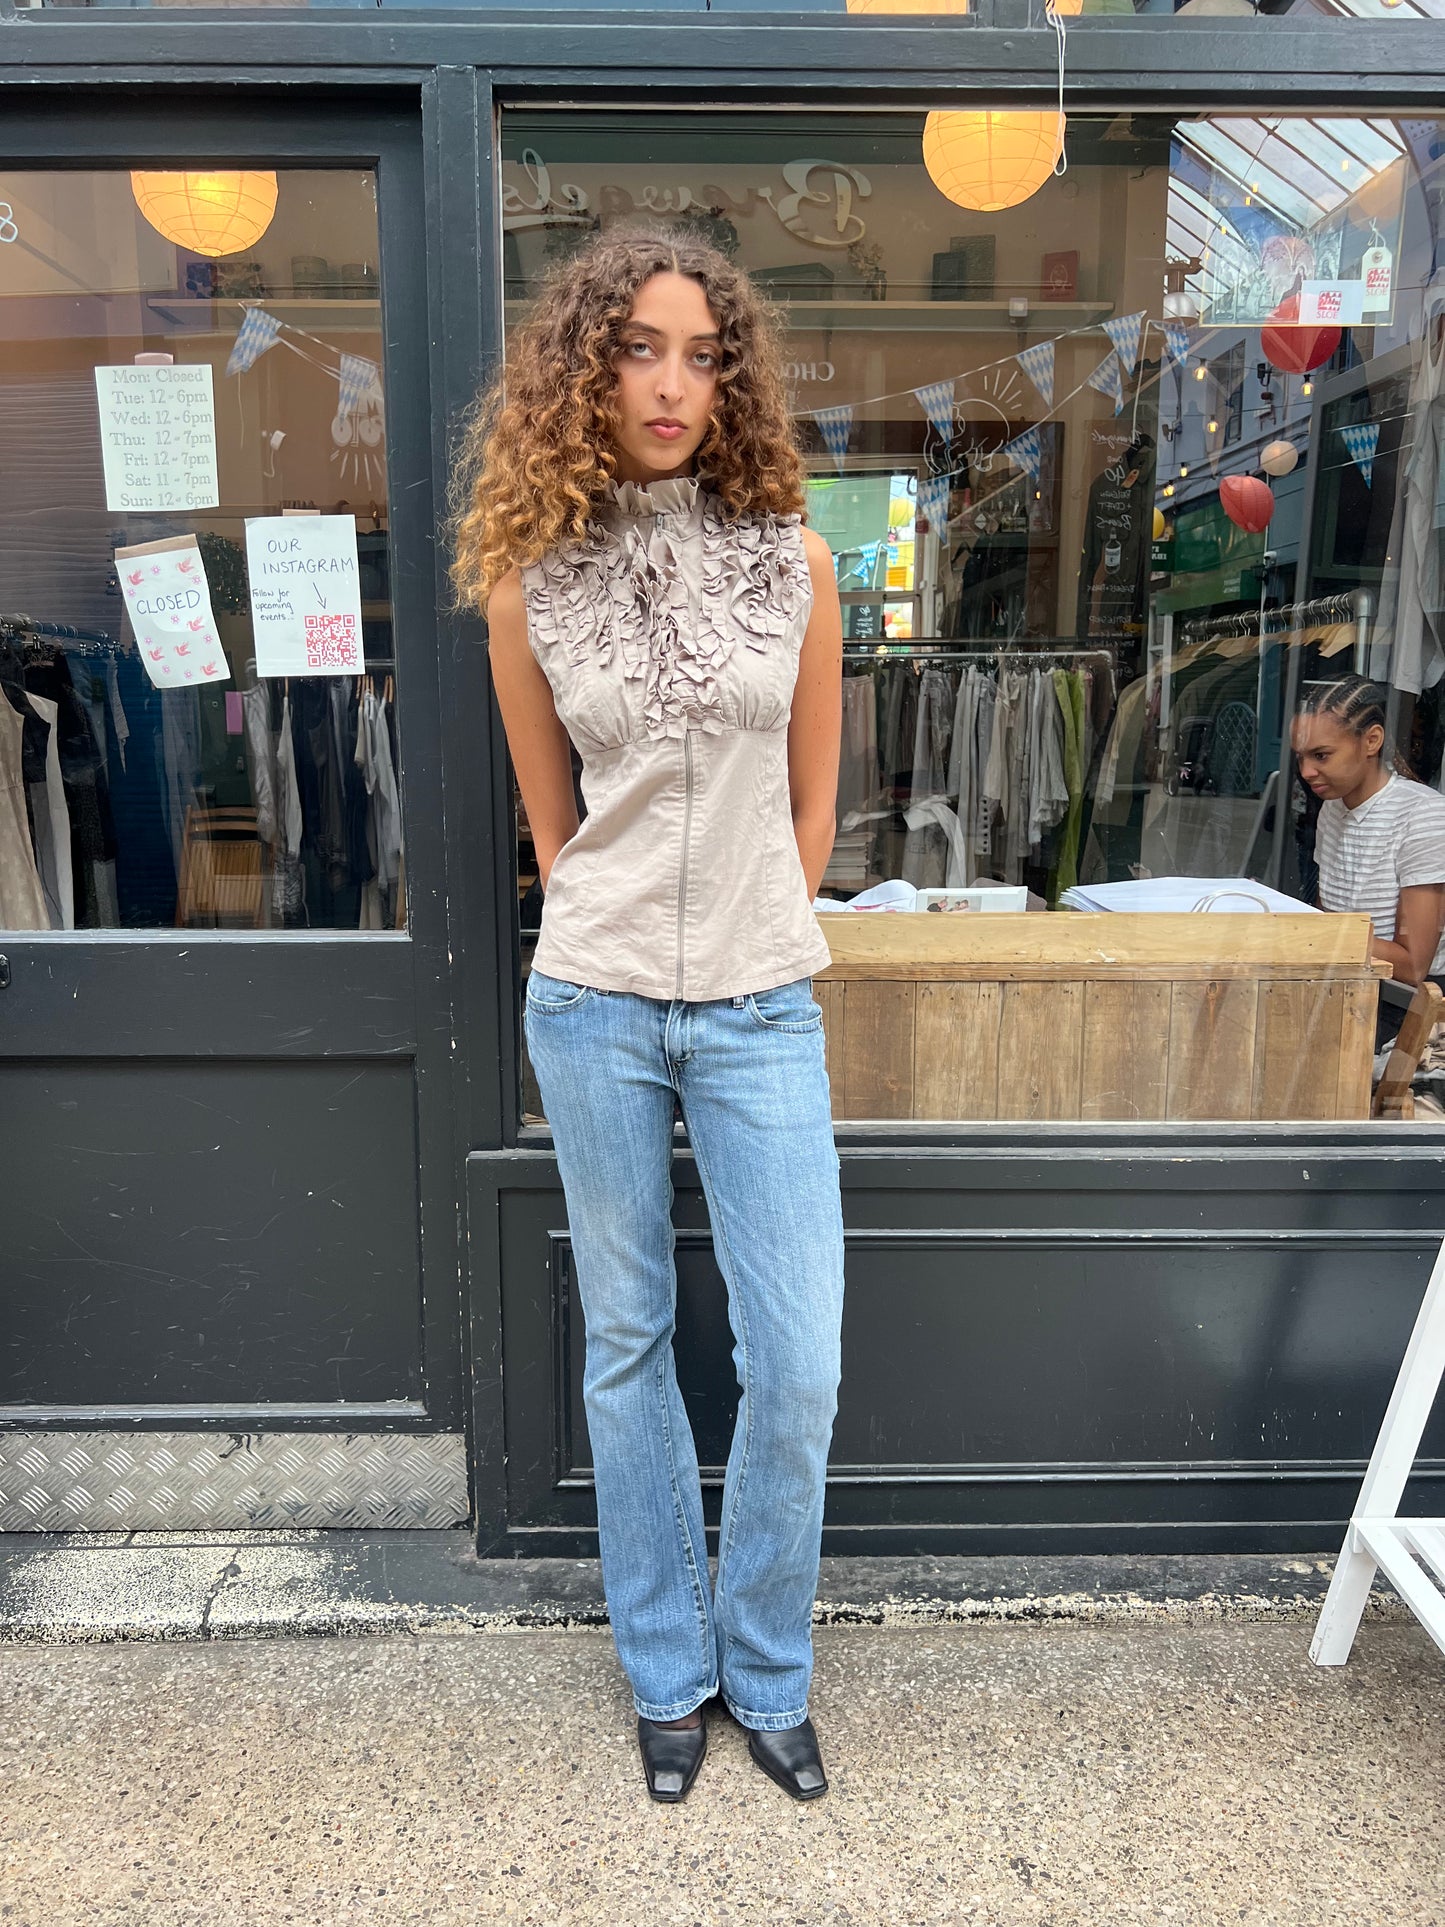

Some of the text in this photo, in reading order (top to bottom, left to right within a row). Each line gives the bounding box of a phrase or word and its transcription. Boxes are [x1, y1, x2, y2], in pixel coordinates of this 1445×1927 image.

[1316, 311, 1338, 319] SLOE
[112, 368, 203, 384] Mon: Closed
[112, 391, 144, 405] Tue:
[149, 389, 166, 404] 12
[176, 390, 208, 407] 6pm
[110, 411, 150, 425] Wed:
[156, 410, 171, 425] 12
[183, 411, 212, 427] 6pm
[110, 432, 145, 446] Thu:
[156, 431, 171, 445] 12
[183, 431, 212, 447] 7pm
[124, 453, 148, 466] Fri:
[154, 451, 169, 465] 12
[181, 452, 210, 468] 7pm
[125, 473, 151, 486] Sat:
[157, 473, 169, 486] 11
[184, 472, 211, 488] 7pm
[121, 494, 153, 506] Sun:
[159, 492, 175, 506] 12
[186, 493, 214, 507] 6pm
[267, 538, 302, 553] OUR
[263, 557, 354, 574] INSTAGRAM
[136, 589, 201, 615] CLOSED
[252, 588, 291, 602] Follow for
[255, 601, 294, 614] upcoming
